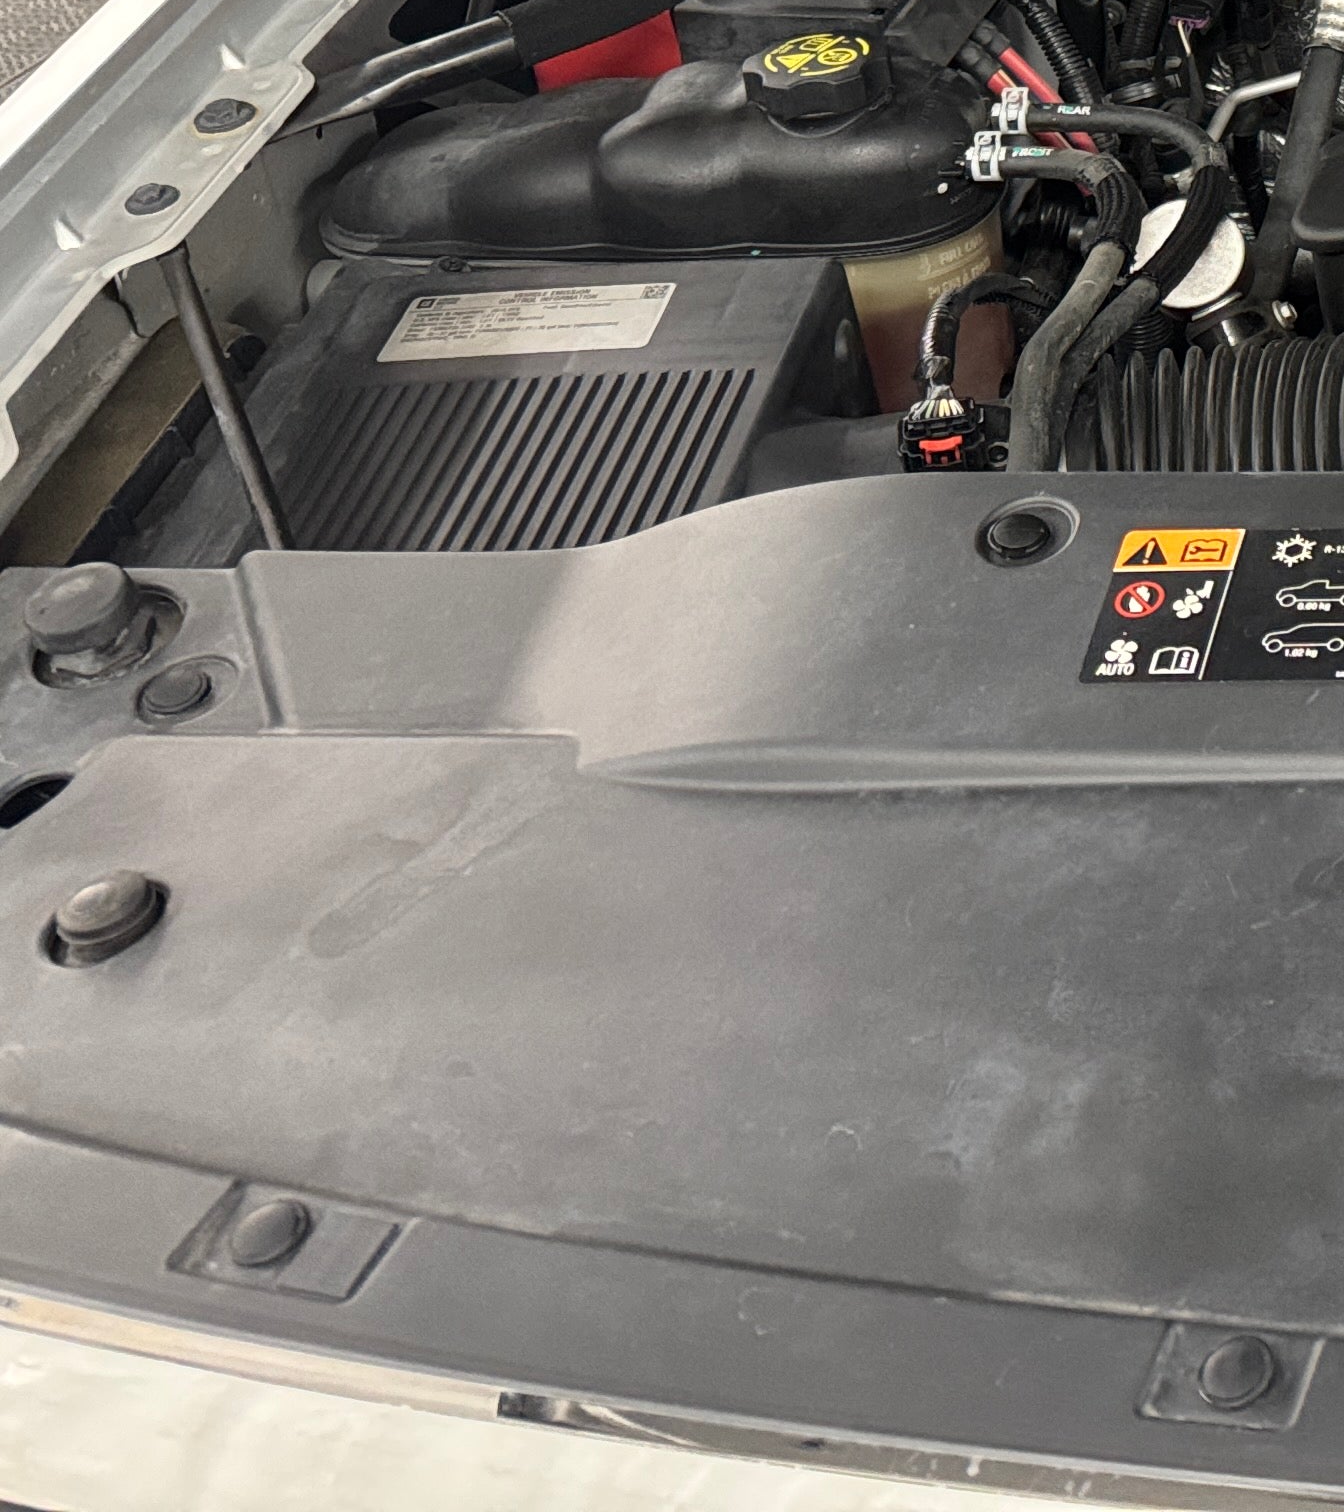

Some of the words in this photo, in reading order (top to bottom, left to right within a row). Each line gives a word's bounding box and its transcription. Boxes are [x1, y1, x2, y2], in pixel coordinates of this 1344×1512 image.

[1319, 602, 1332, 612] kg
[1305, 648, 1319, 659] kg
[1096, 662, 1135, 676] AUTO
